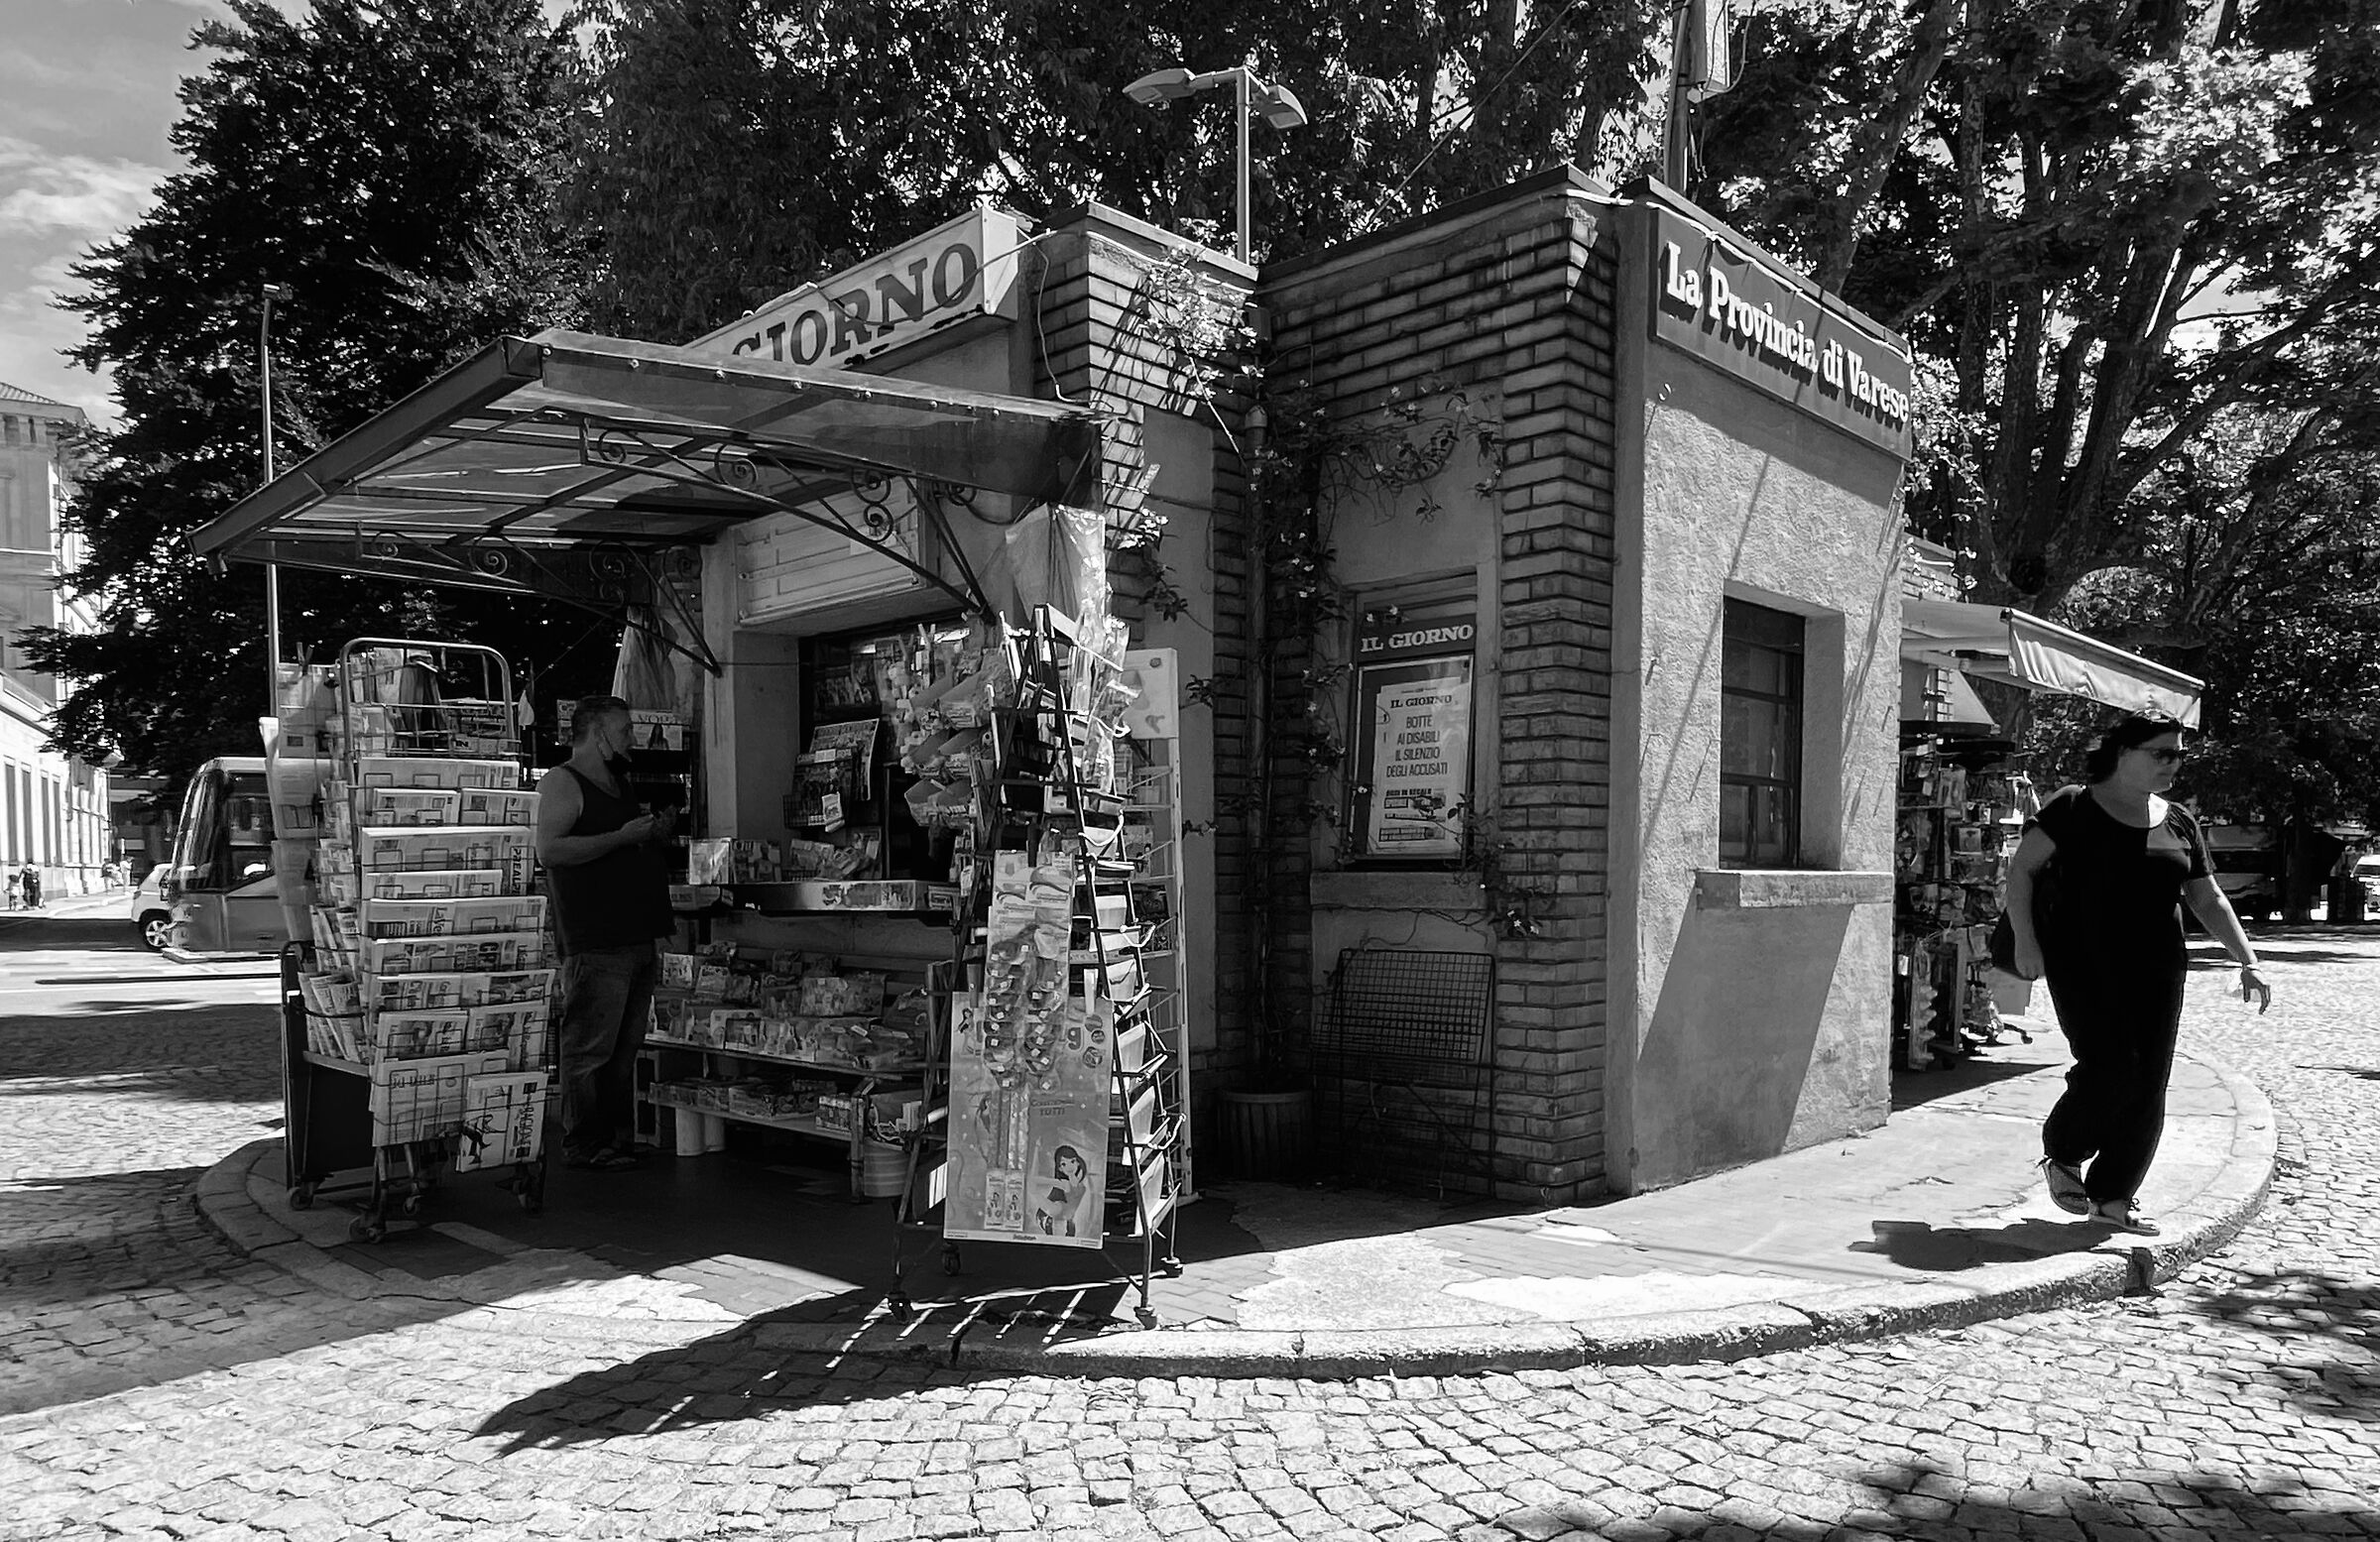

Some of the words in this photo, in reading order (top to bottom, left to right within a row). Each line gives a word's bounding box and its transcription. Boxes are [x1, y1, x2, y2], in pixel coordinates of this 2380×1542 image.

[1666, 241, 1703, 309] La
[1708, 266, 1819, 375] Provincia
[1823, 339, 1844, 390] di
[1844, 349, 1909, 423] Varese
[1361, 636, 1384, 652] IL
[1388, 624, 1475, 650] GIORNO
[1390, 698, 1403, 709] IL
[1405, 694, 1453, 708] GIORNO
[1405, 713, 1433, 729] BOTTE
[1396, 732, 1406, 745] AI
[1406, 729, 1441, 745] DISABILI
[1394, 749, 1402, 762] IL
[1402, 746, 1441, 761] SILENZIO
[1385, 764, 1408, 777] DEGLI
[1408, 761, 1448, 776] ACCUSATI
